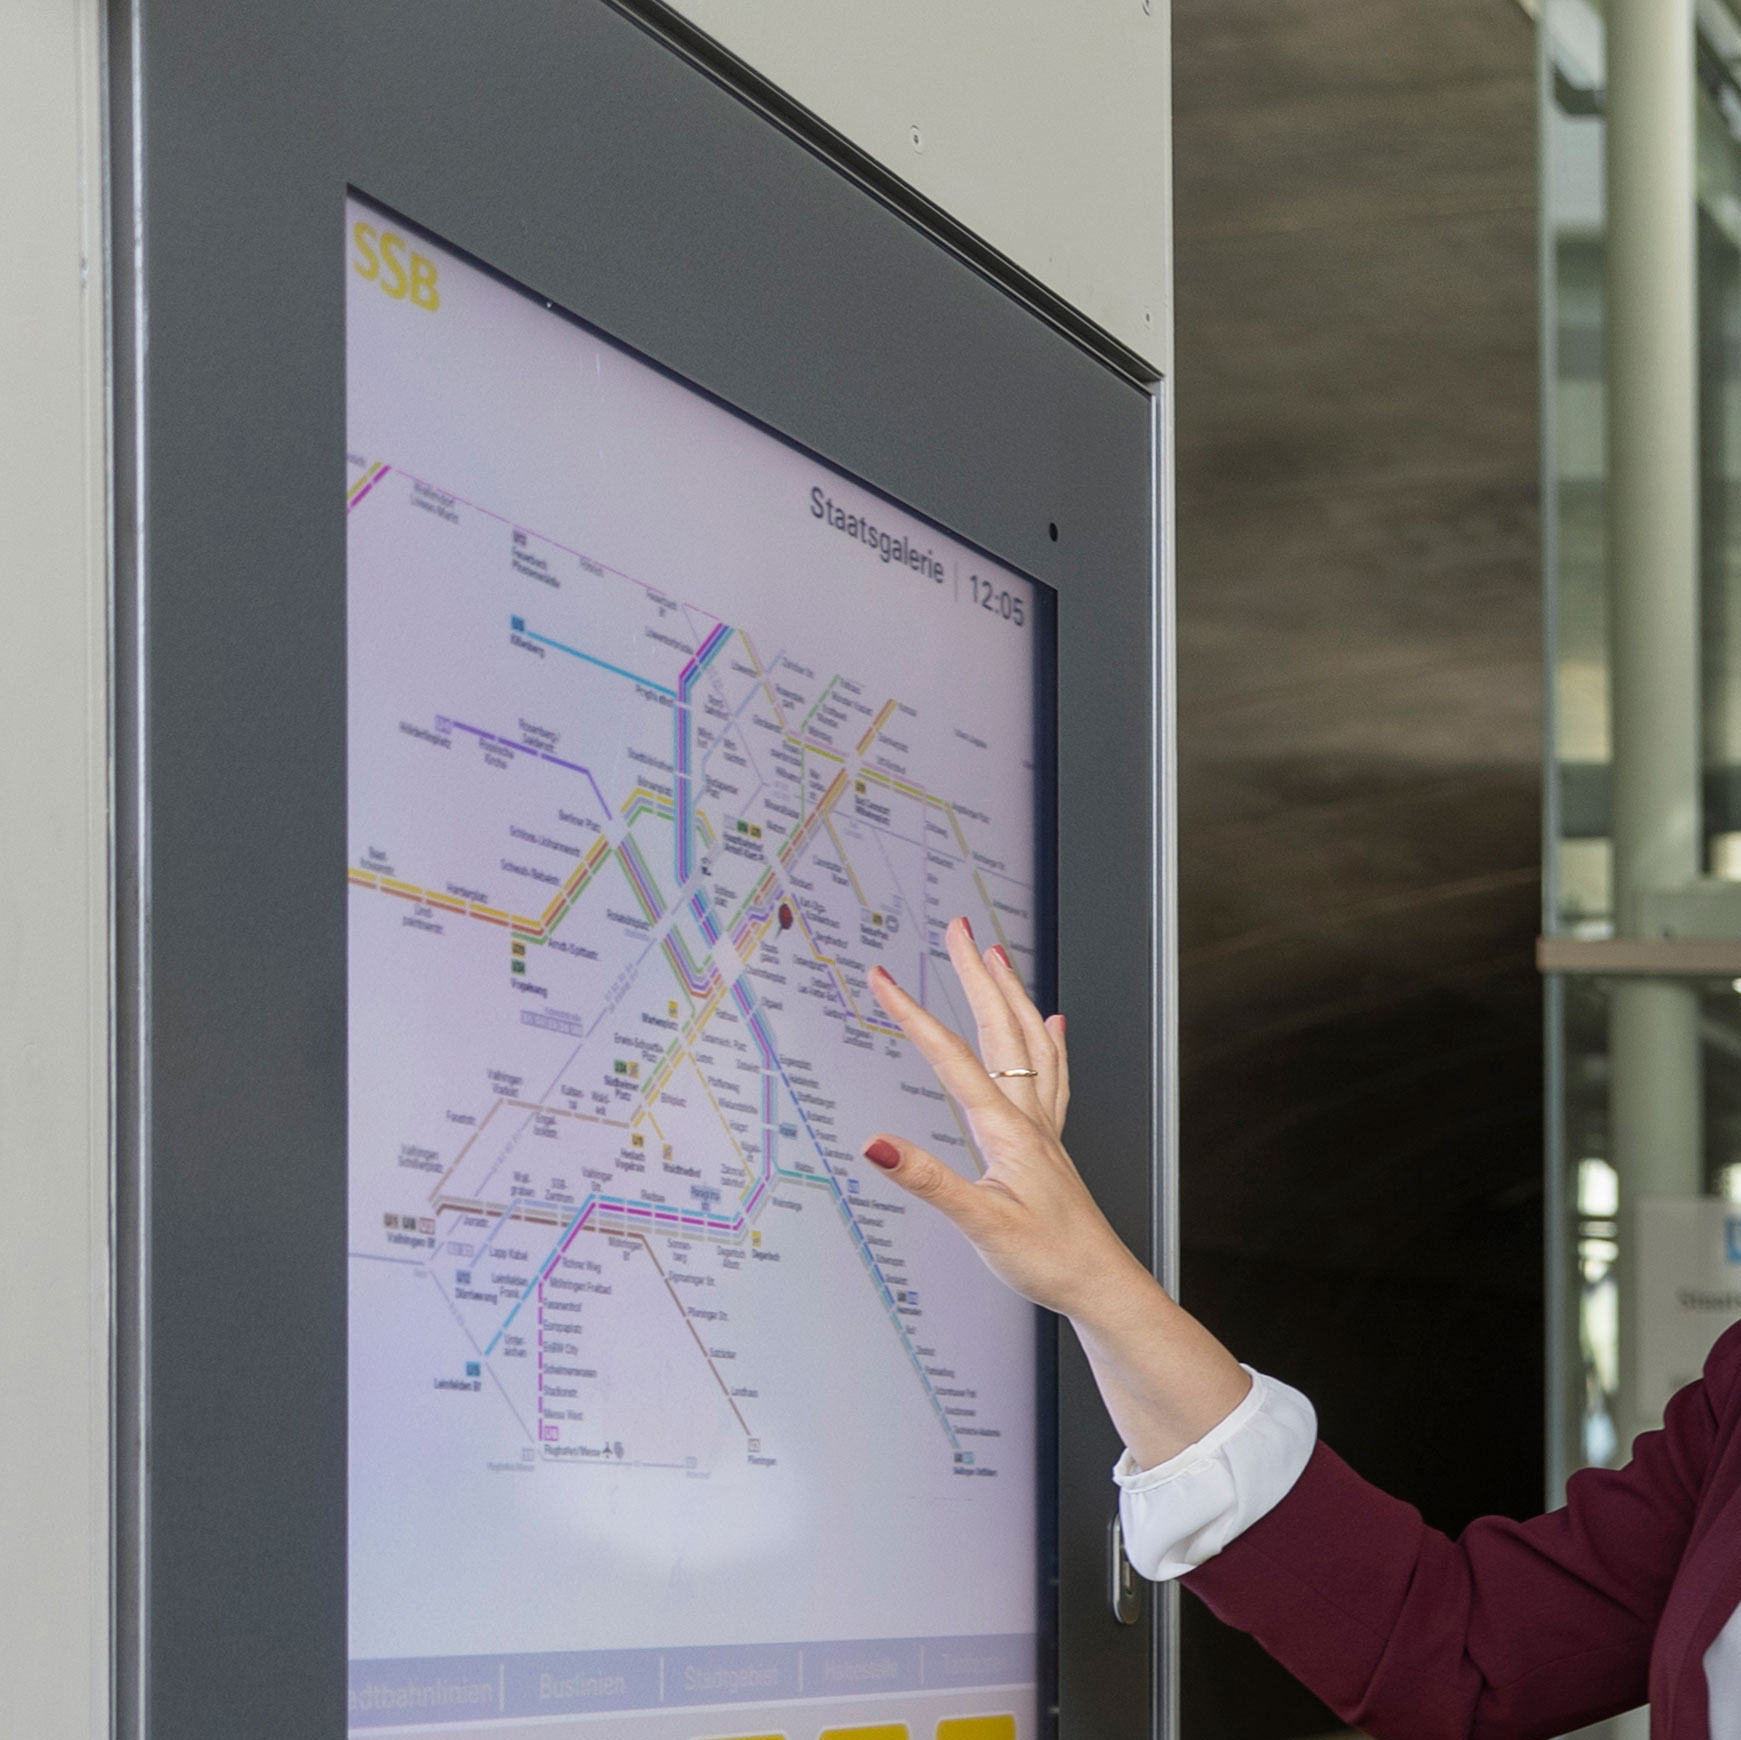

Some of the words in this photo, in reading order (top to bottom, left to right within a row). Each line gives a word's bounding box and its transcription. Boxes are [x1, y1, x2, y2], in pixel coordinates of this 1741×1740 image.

[351, 221, 441, 313] SSB
[809, 486, 945, 586] Staatsgalerie
[968, 574, 1026, 628] 12:05
